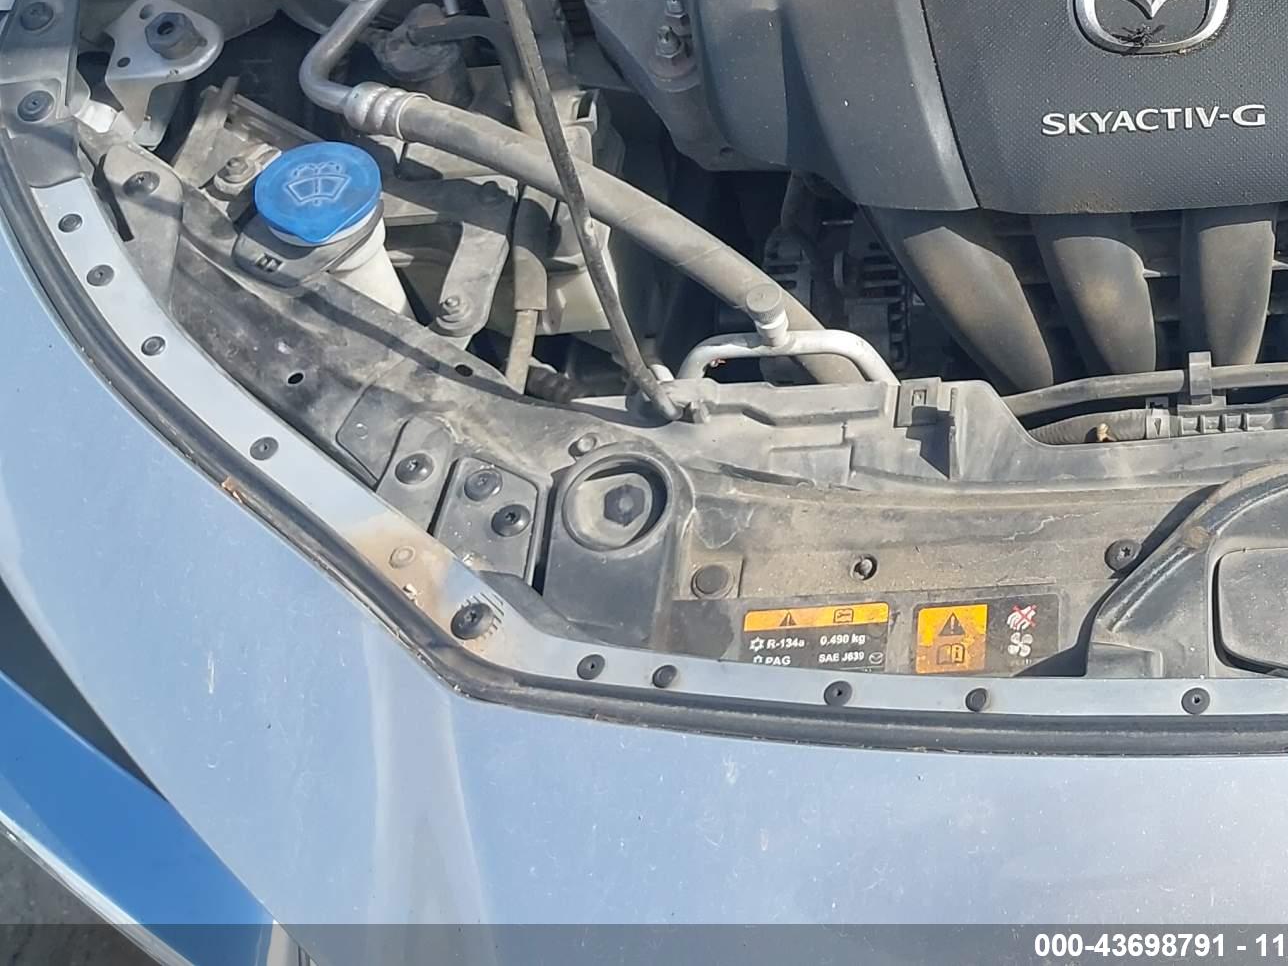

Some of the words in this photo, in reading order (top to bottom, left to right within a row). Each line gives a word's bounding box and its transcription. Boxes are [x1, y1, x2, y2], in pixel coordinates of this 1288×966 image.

[1041, 104, 1267, 136] SKYACTIV-G
[766, 638, 805, 650] R-134a
[851, 633, 866, 645] kg
[764, 655, 791, 666] PAG
[818, 653, 840, 664] SAE
[841, 651, 865, 662] J639
